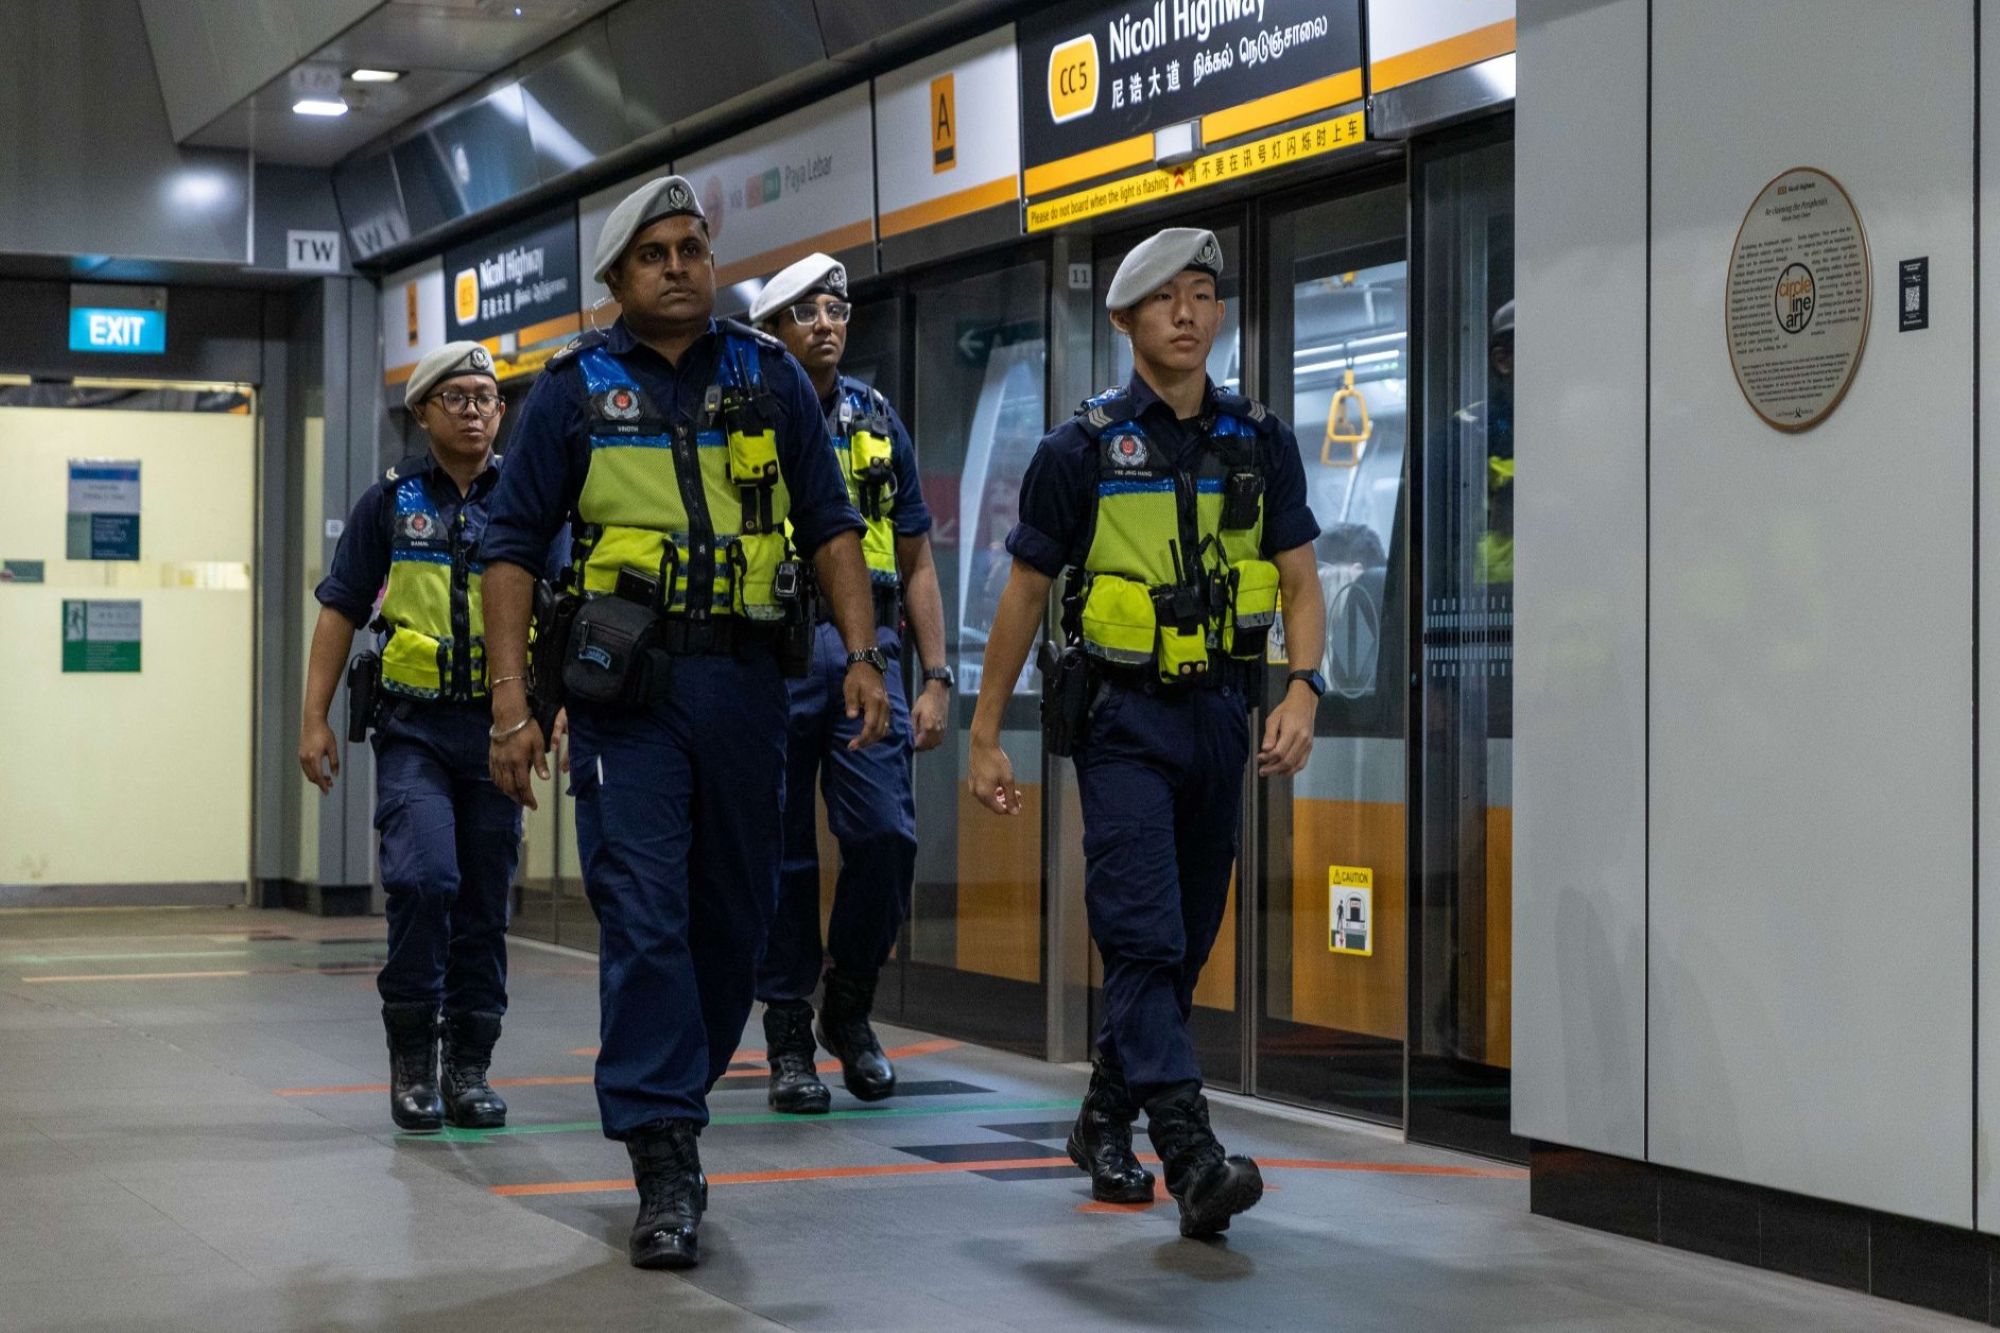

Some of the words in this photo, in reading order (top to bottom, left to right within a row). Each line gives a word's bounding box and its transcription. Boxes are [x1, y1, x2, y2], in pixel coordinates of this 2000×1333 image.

[1109, 0, 1167, 64] Nicoll
[936, 92, 950, 141] A
[1030, 209, 1050, 226] Please
[1050, 203, 1058, 221] do
[1059, 203, 1070, 218] not
[1071, 197, 1089, 214] board
[1090, 193, 1108, 209] when
[1108, 189, 1119, 205] the
[1120, 185, 1136, 204] light
[1143, 176, 1170, 194] flashing
[293, 238, 334, 262] TW
[1072, 269, 1088, 284] 11
[89, 314, 146, 347] EXIT
[1341, 870, 1369, 884] CAUTION
